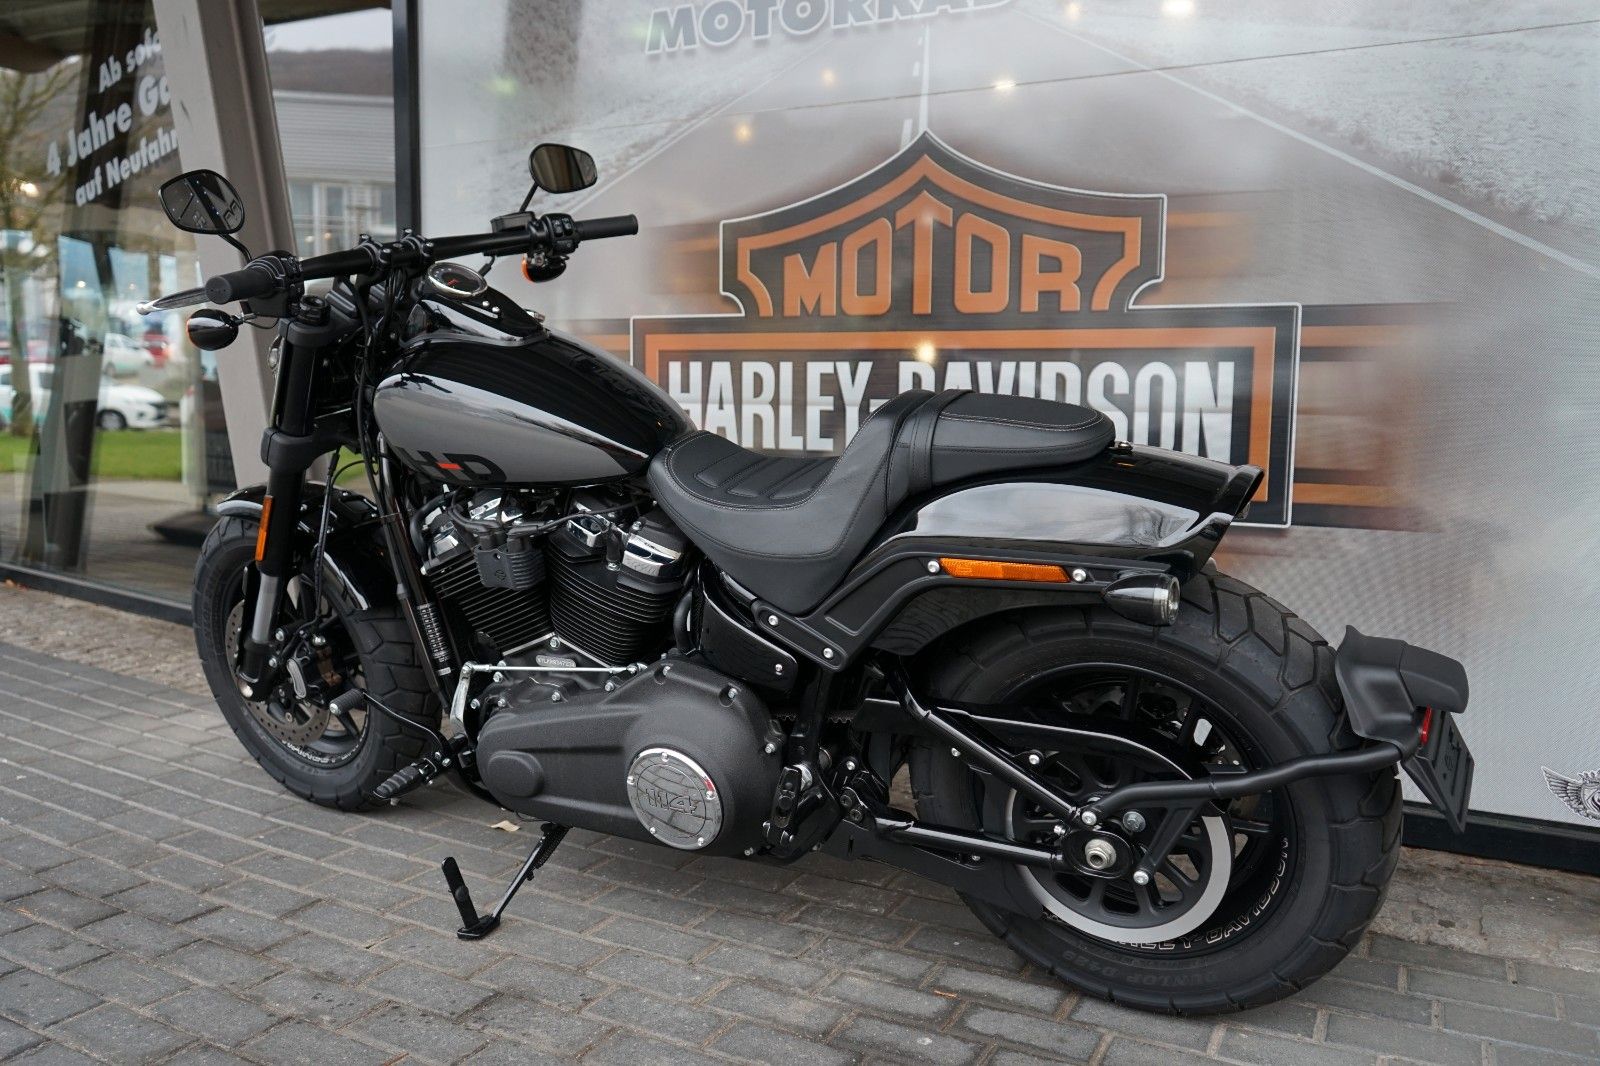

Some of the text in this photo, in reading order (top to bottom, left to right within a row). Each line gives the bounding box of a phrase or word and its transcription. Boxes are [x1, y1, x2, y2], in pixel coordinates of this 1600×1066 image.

[645, 0, 1012, 54] MOTOR
[98, 55, 122, 94] Ab
[47, 141, 62, 176] 4
[68, 102, 132, 167] Jahre
[75, 165, 103, 207] auf
[783, 189, 1082, 317] MOTOR
